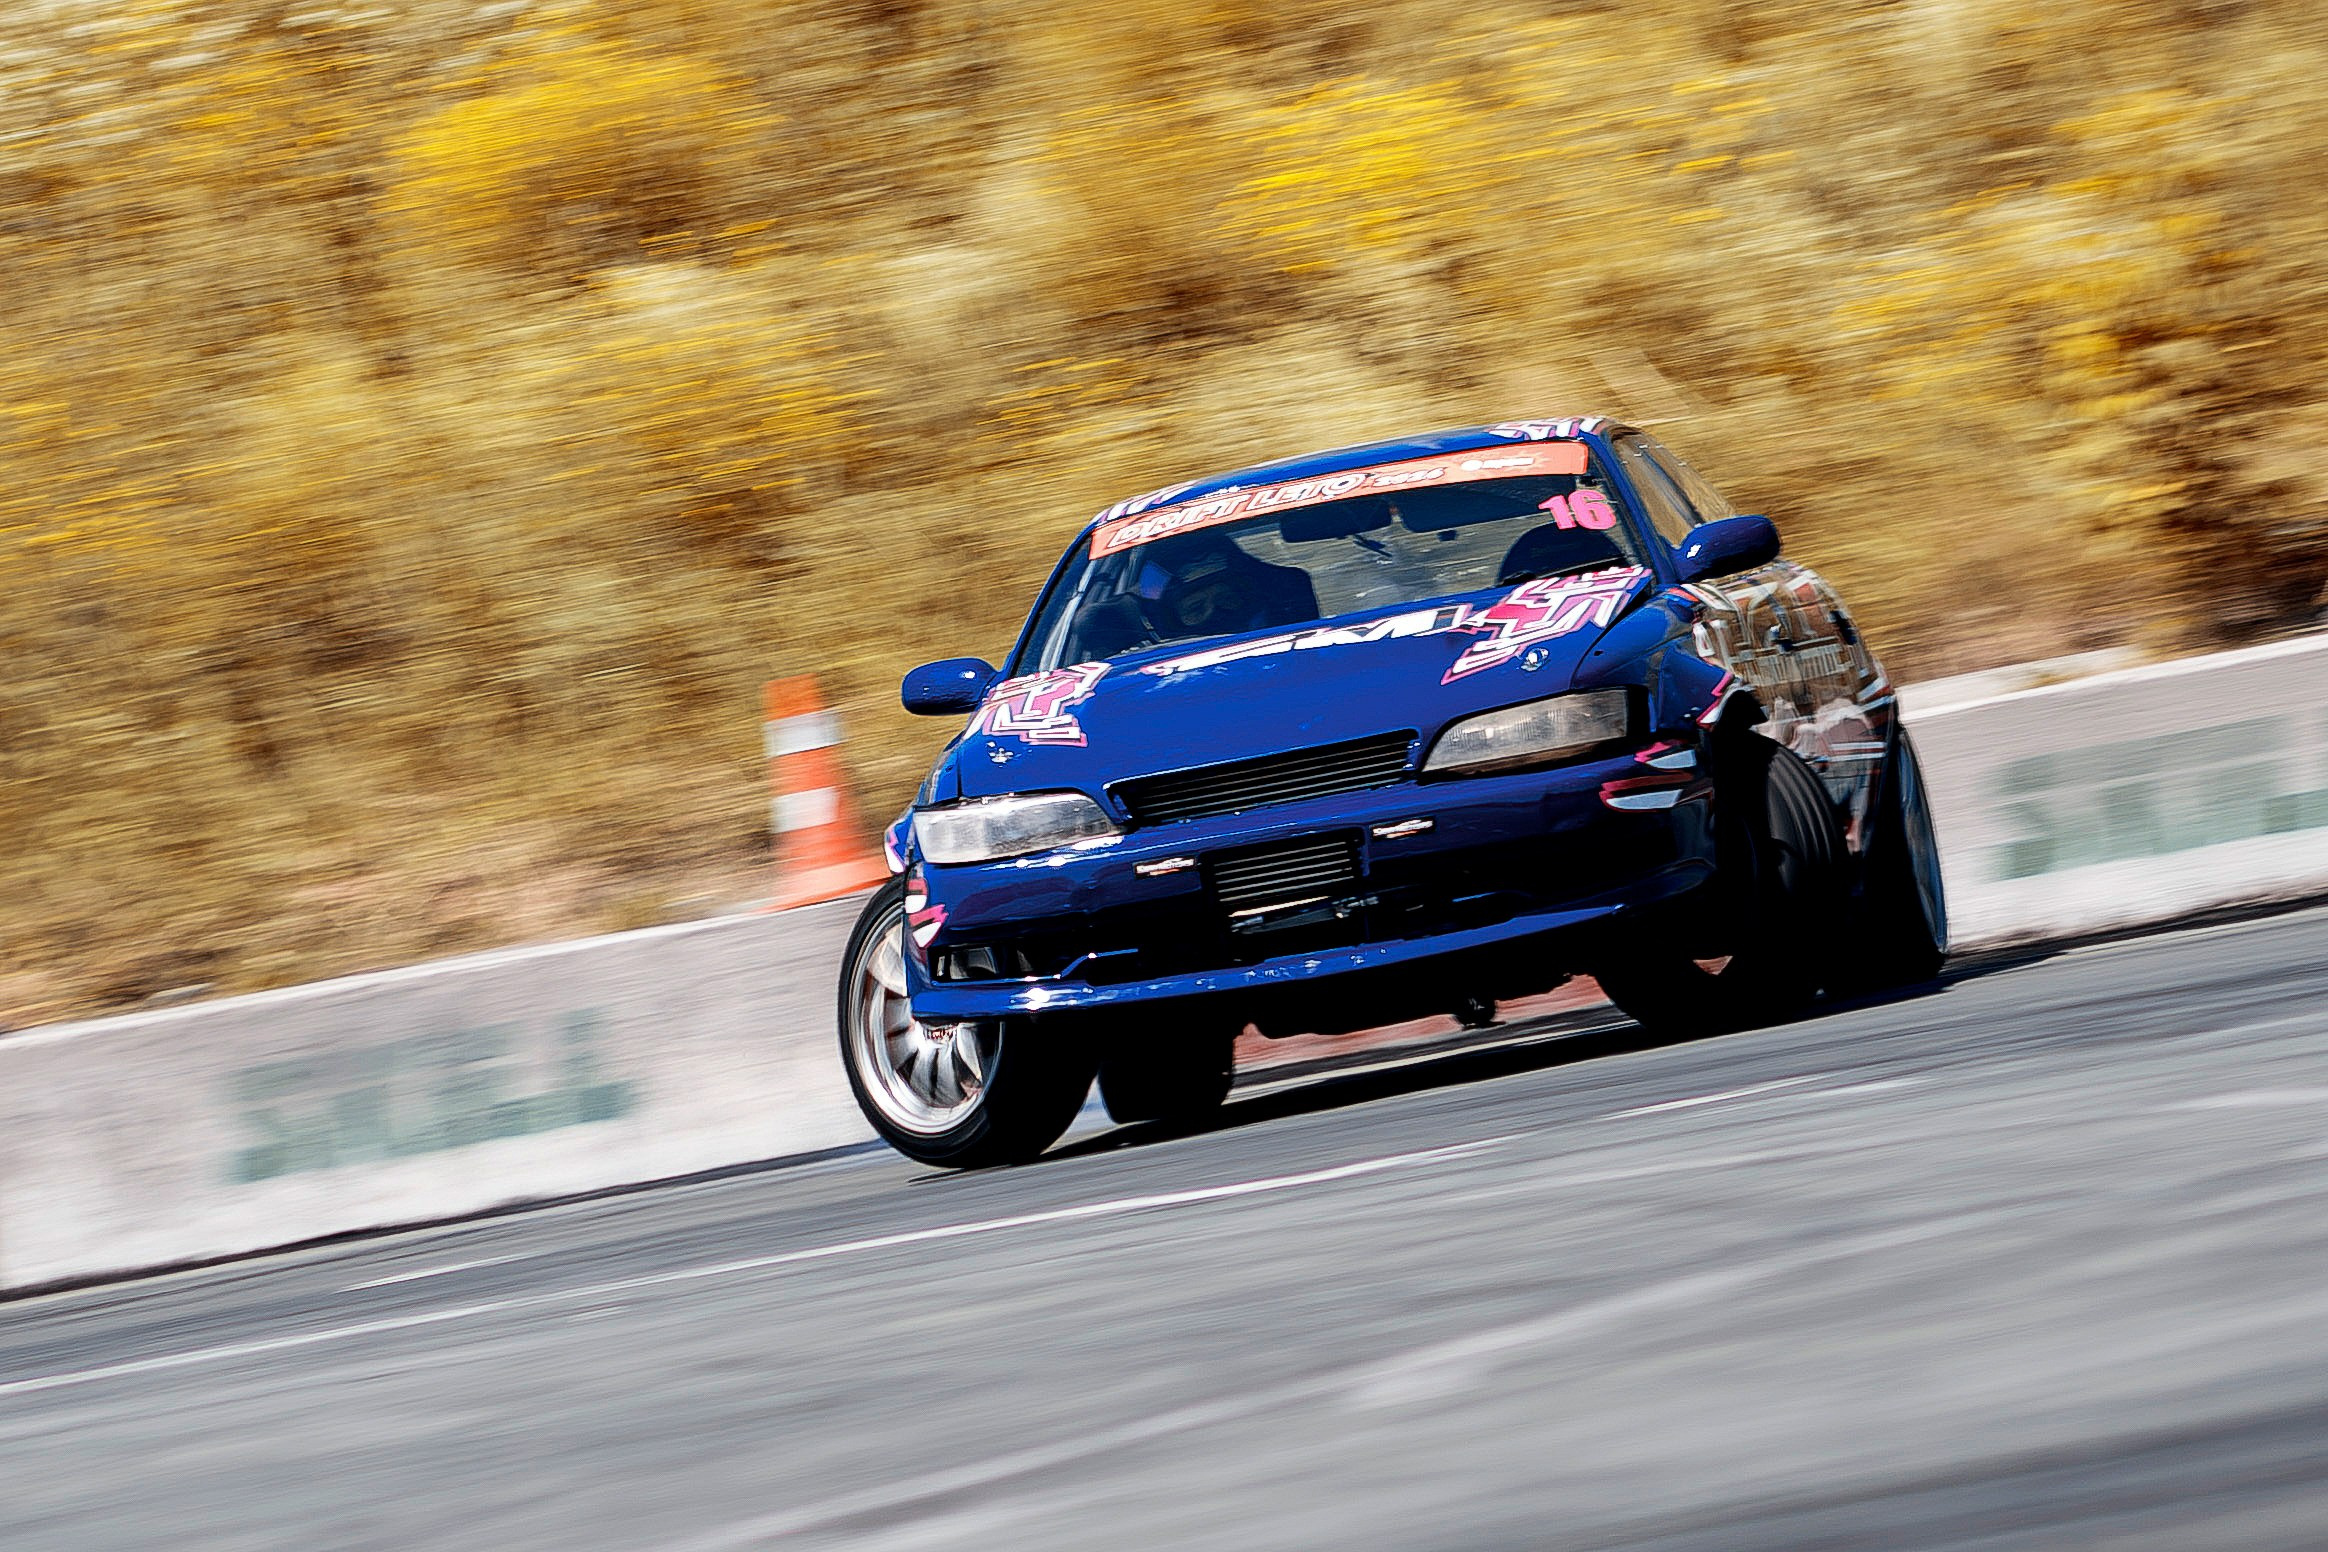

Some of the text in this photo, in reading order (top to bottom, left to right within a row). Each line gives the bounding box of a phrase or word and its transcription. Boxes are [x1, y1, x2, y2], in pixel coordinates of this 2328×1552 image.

[1106, 493, 1251, 549] DRIFT
[1245, 472, 1367, 512] LETO
[1538, 489, 1617, 530] 16
